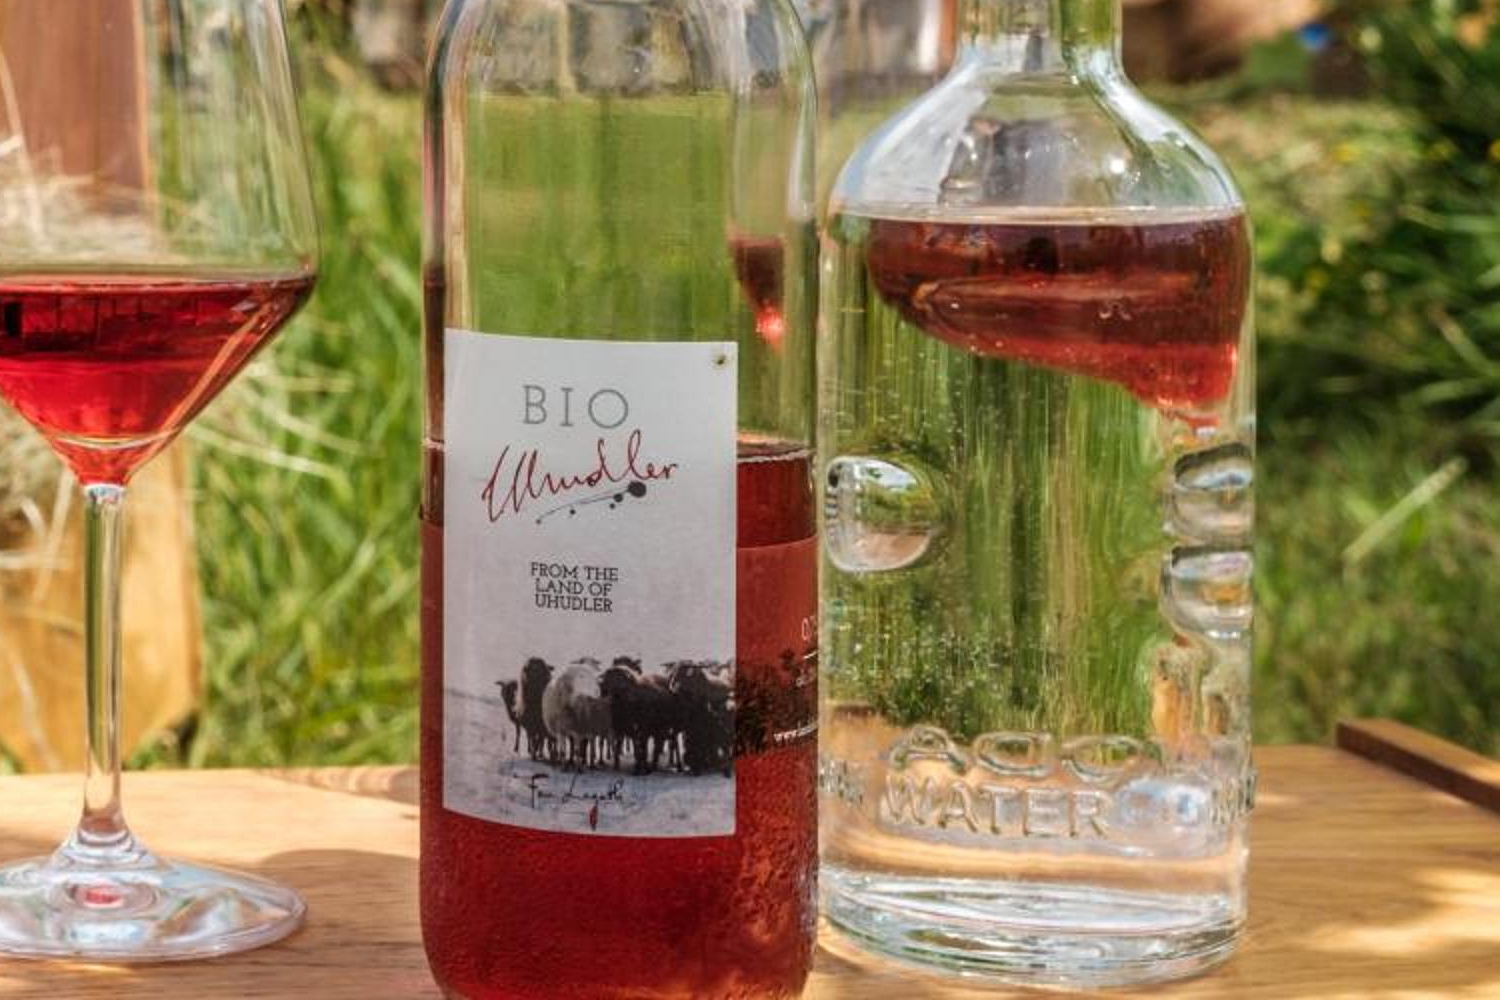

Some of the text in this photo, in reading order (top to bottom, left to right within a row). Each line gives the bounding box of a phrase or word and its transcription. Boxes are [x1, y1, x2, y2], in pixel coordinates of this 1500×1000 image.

[523, 384, 629, 429] BIO
[531, 562, 619, 582] FROM THE
[536, 578, 613, 597] LAND OF
[535, 593, 613, 613] UHUDLER
[884, 773, 1111, 838] WATER
